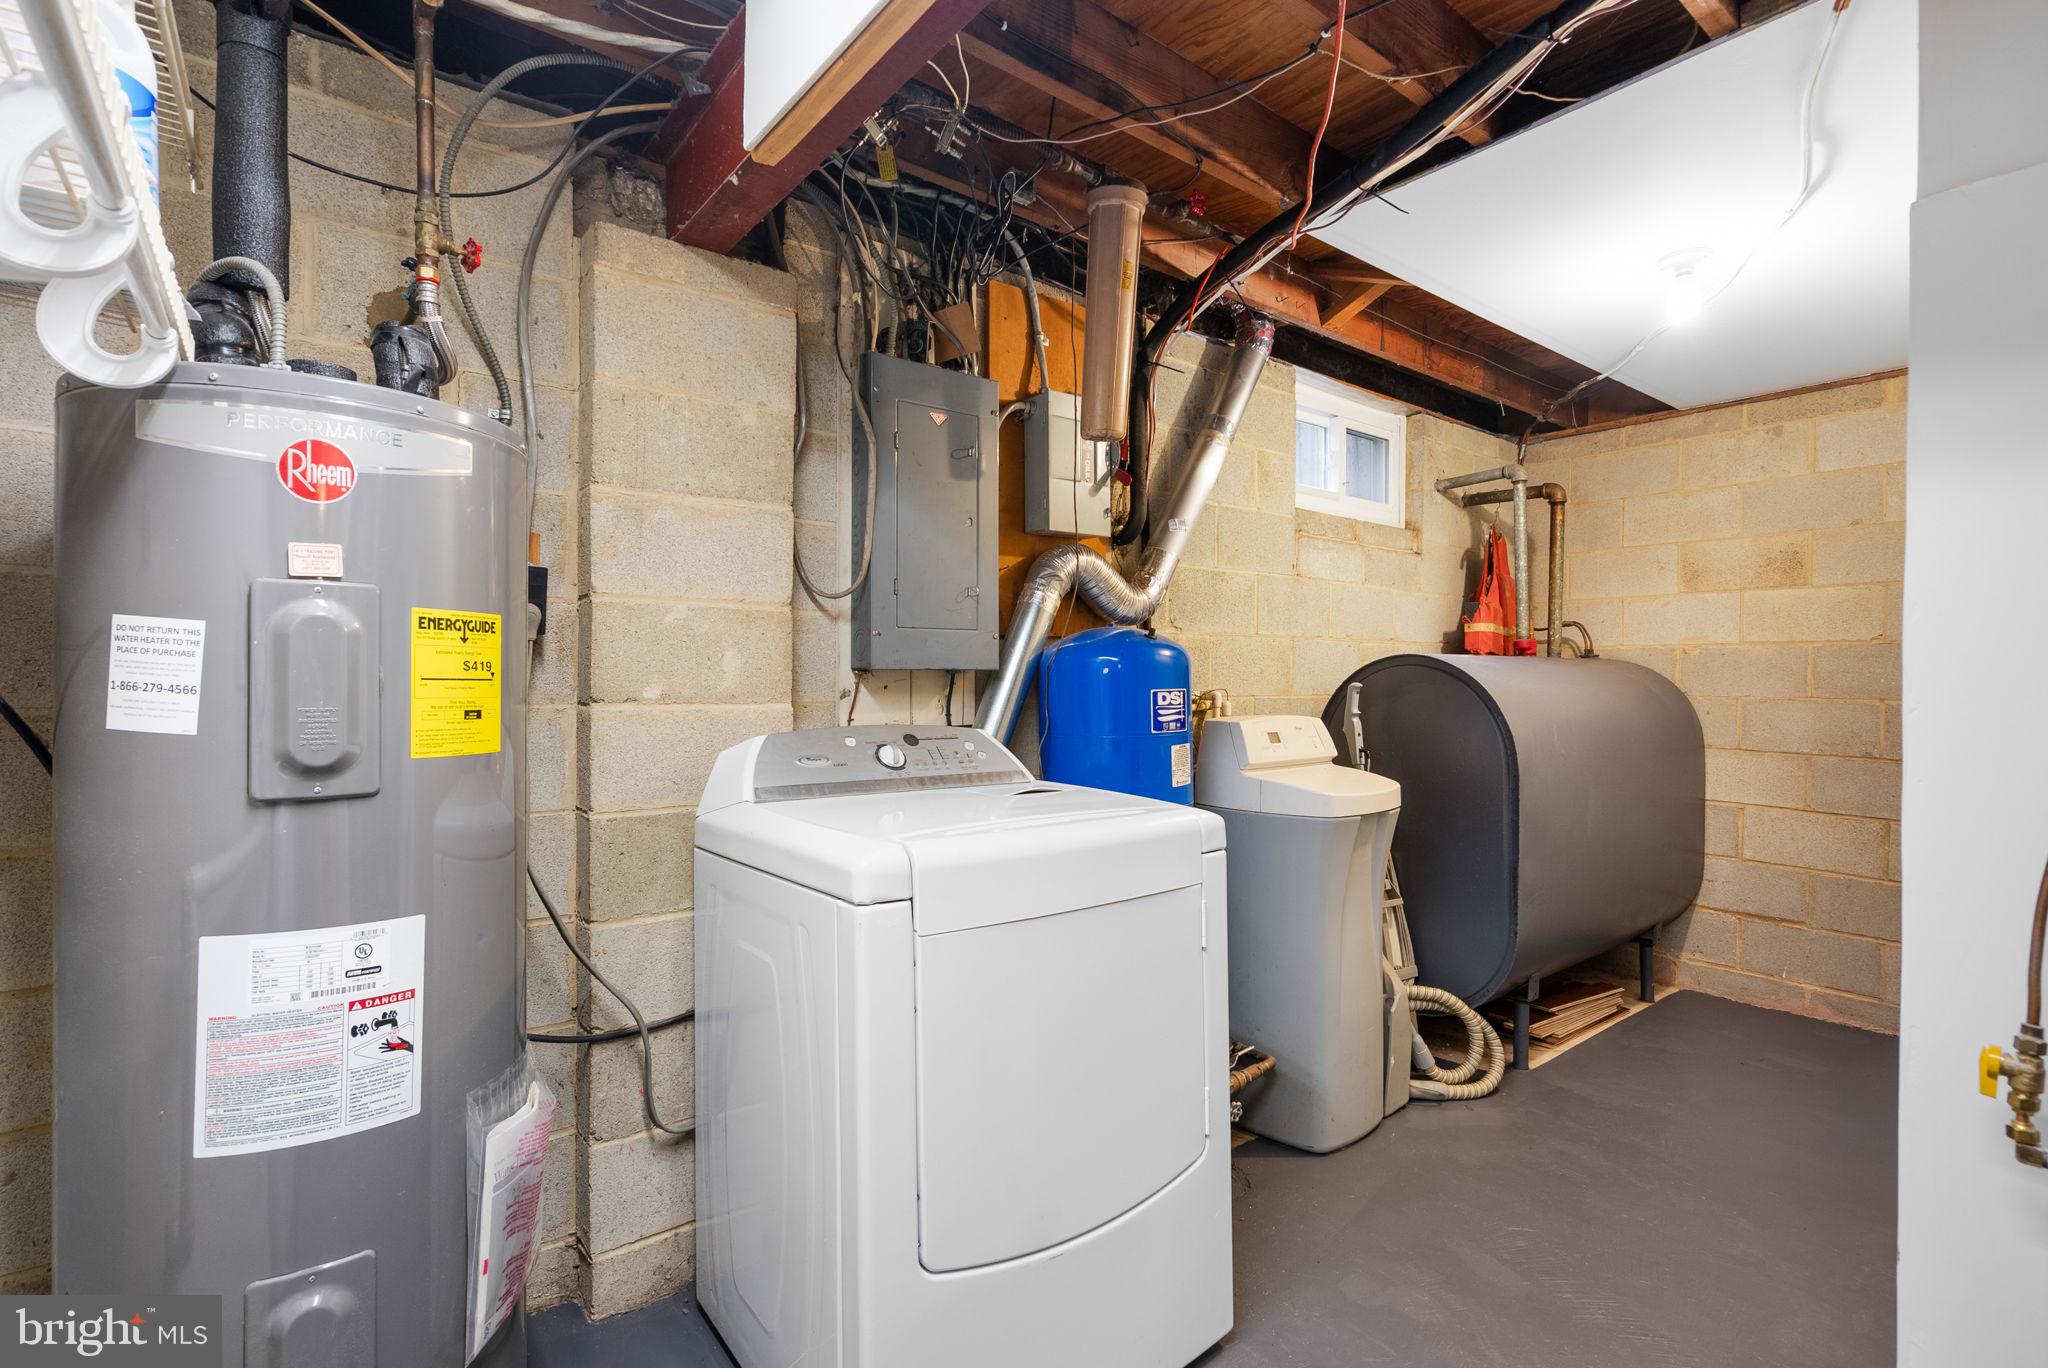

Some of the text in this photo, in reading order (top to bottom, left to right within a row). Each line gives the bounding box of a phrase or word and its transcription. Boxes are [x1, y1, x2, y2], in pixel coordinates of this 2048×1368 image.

[226, 411, 403, 448] PERFORMANCE
[287, 440, 352, 493] Rheem
[116, 623, 127, 631] DO
[146, 626, 180, 635] RETURN
[183, 628, 201, 637] THIS
[418, 616, 496, 636] ENERGYGUIDE
[114, 635, 201, 647] WATER HEATER TO THE
[116, 646, 197, 658] PLACE OF PURCHASE
[111, 680, 197, 695] 1-866-279-4566
[1157, 691, 1184, 706] DSI
[317, 1003, 344, 1011] CAUTION
[364, 991, 412, 1008] DANGER
